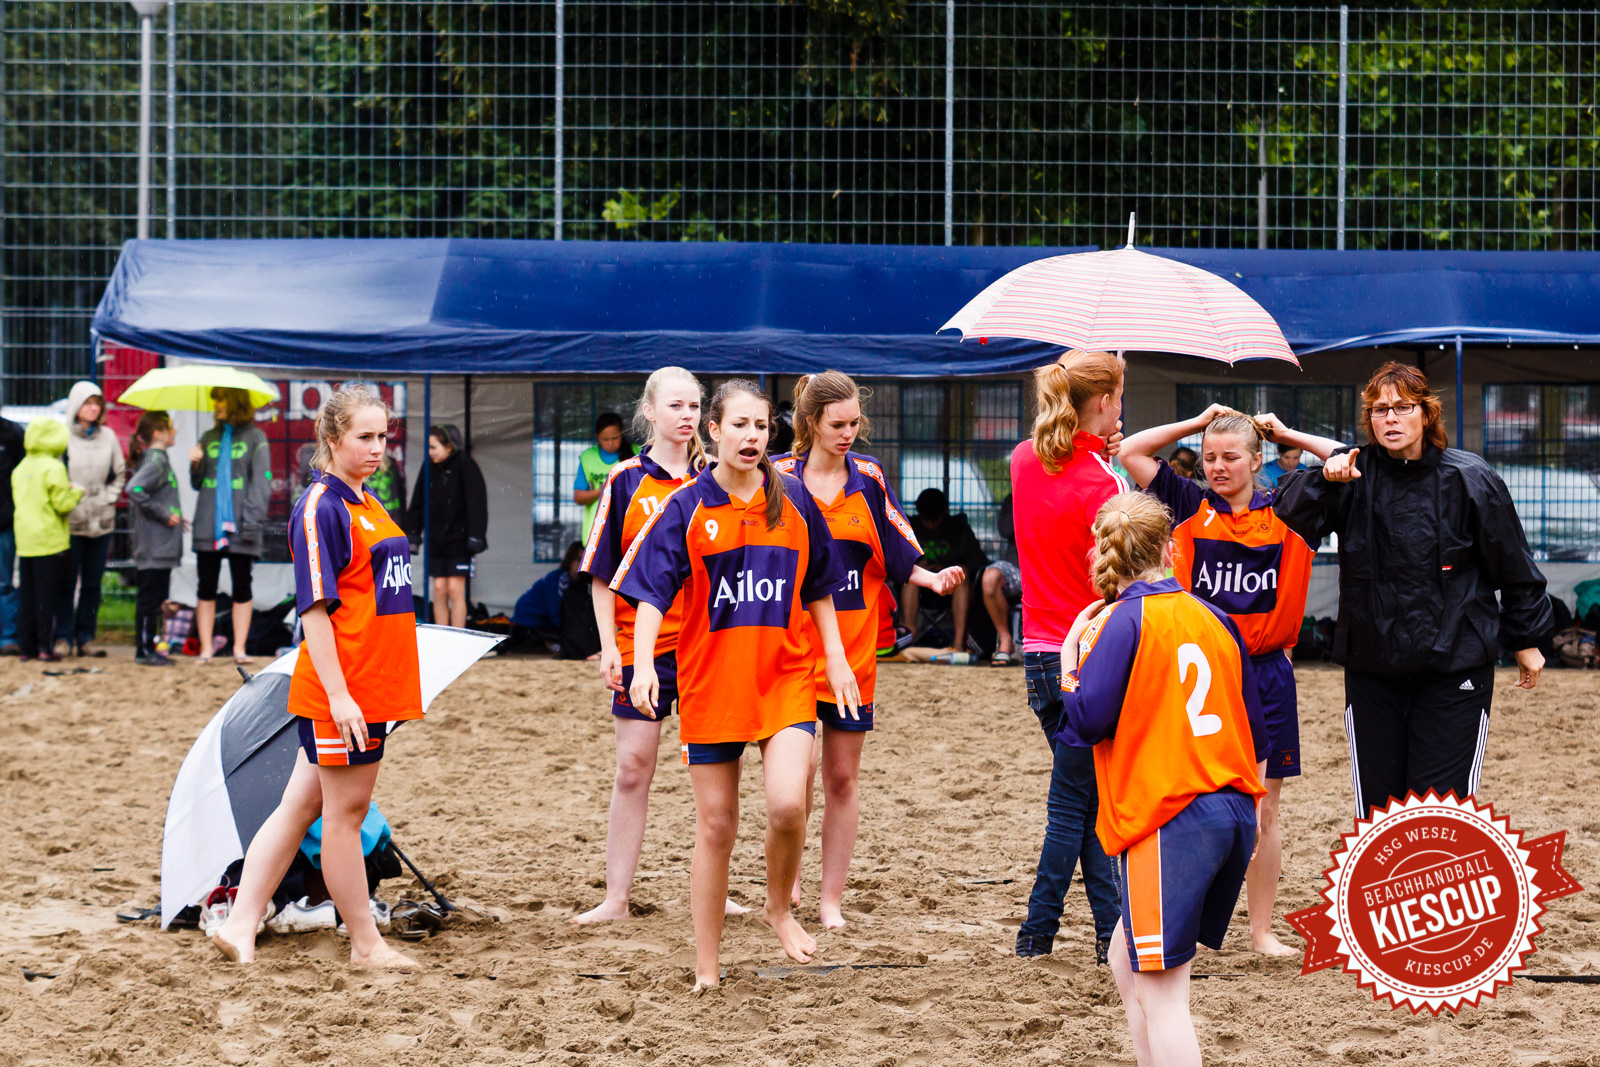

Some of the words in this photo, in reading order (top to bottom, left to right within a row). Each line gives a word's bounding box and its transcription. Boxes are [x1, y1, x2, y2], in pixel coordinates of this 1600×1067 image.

[705, 519, 719, 541] 9
[1203, 508, 1216, 528] 7
[1194, 560, 1277, 598] Ajilon
[1177, 643, 1222, 737] 2
